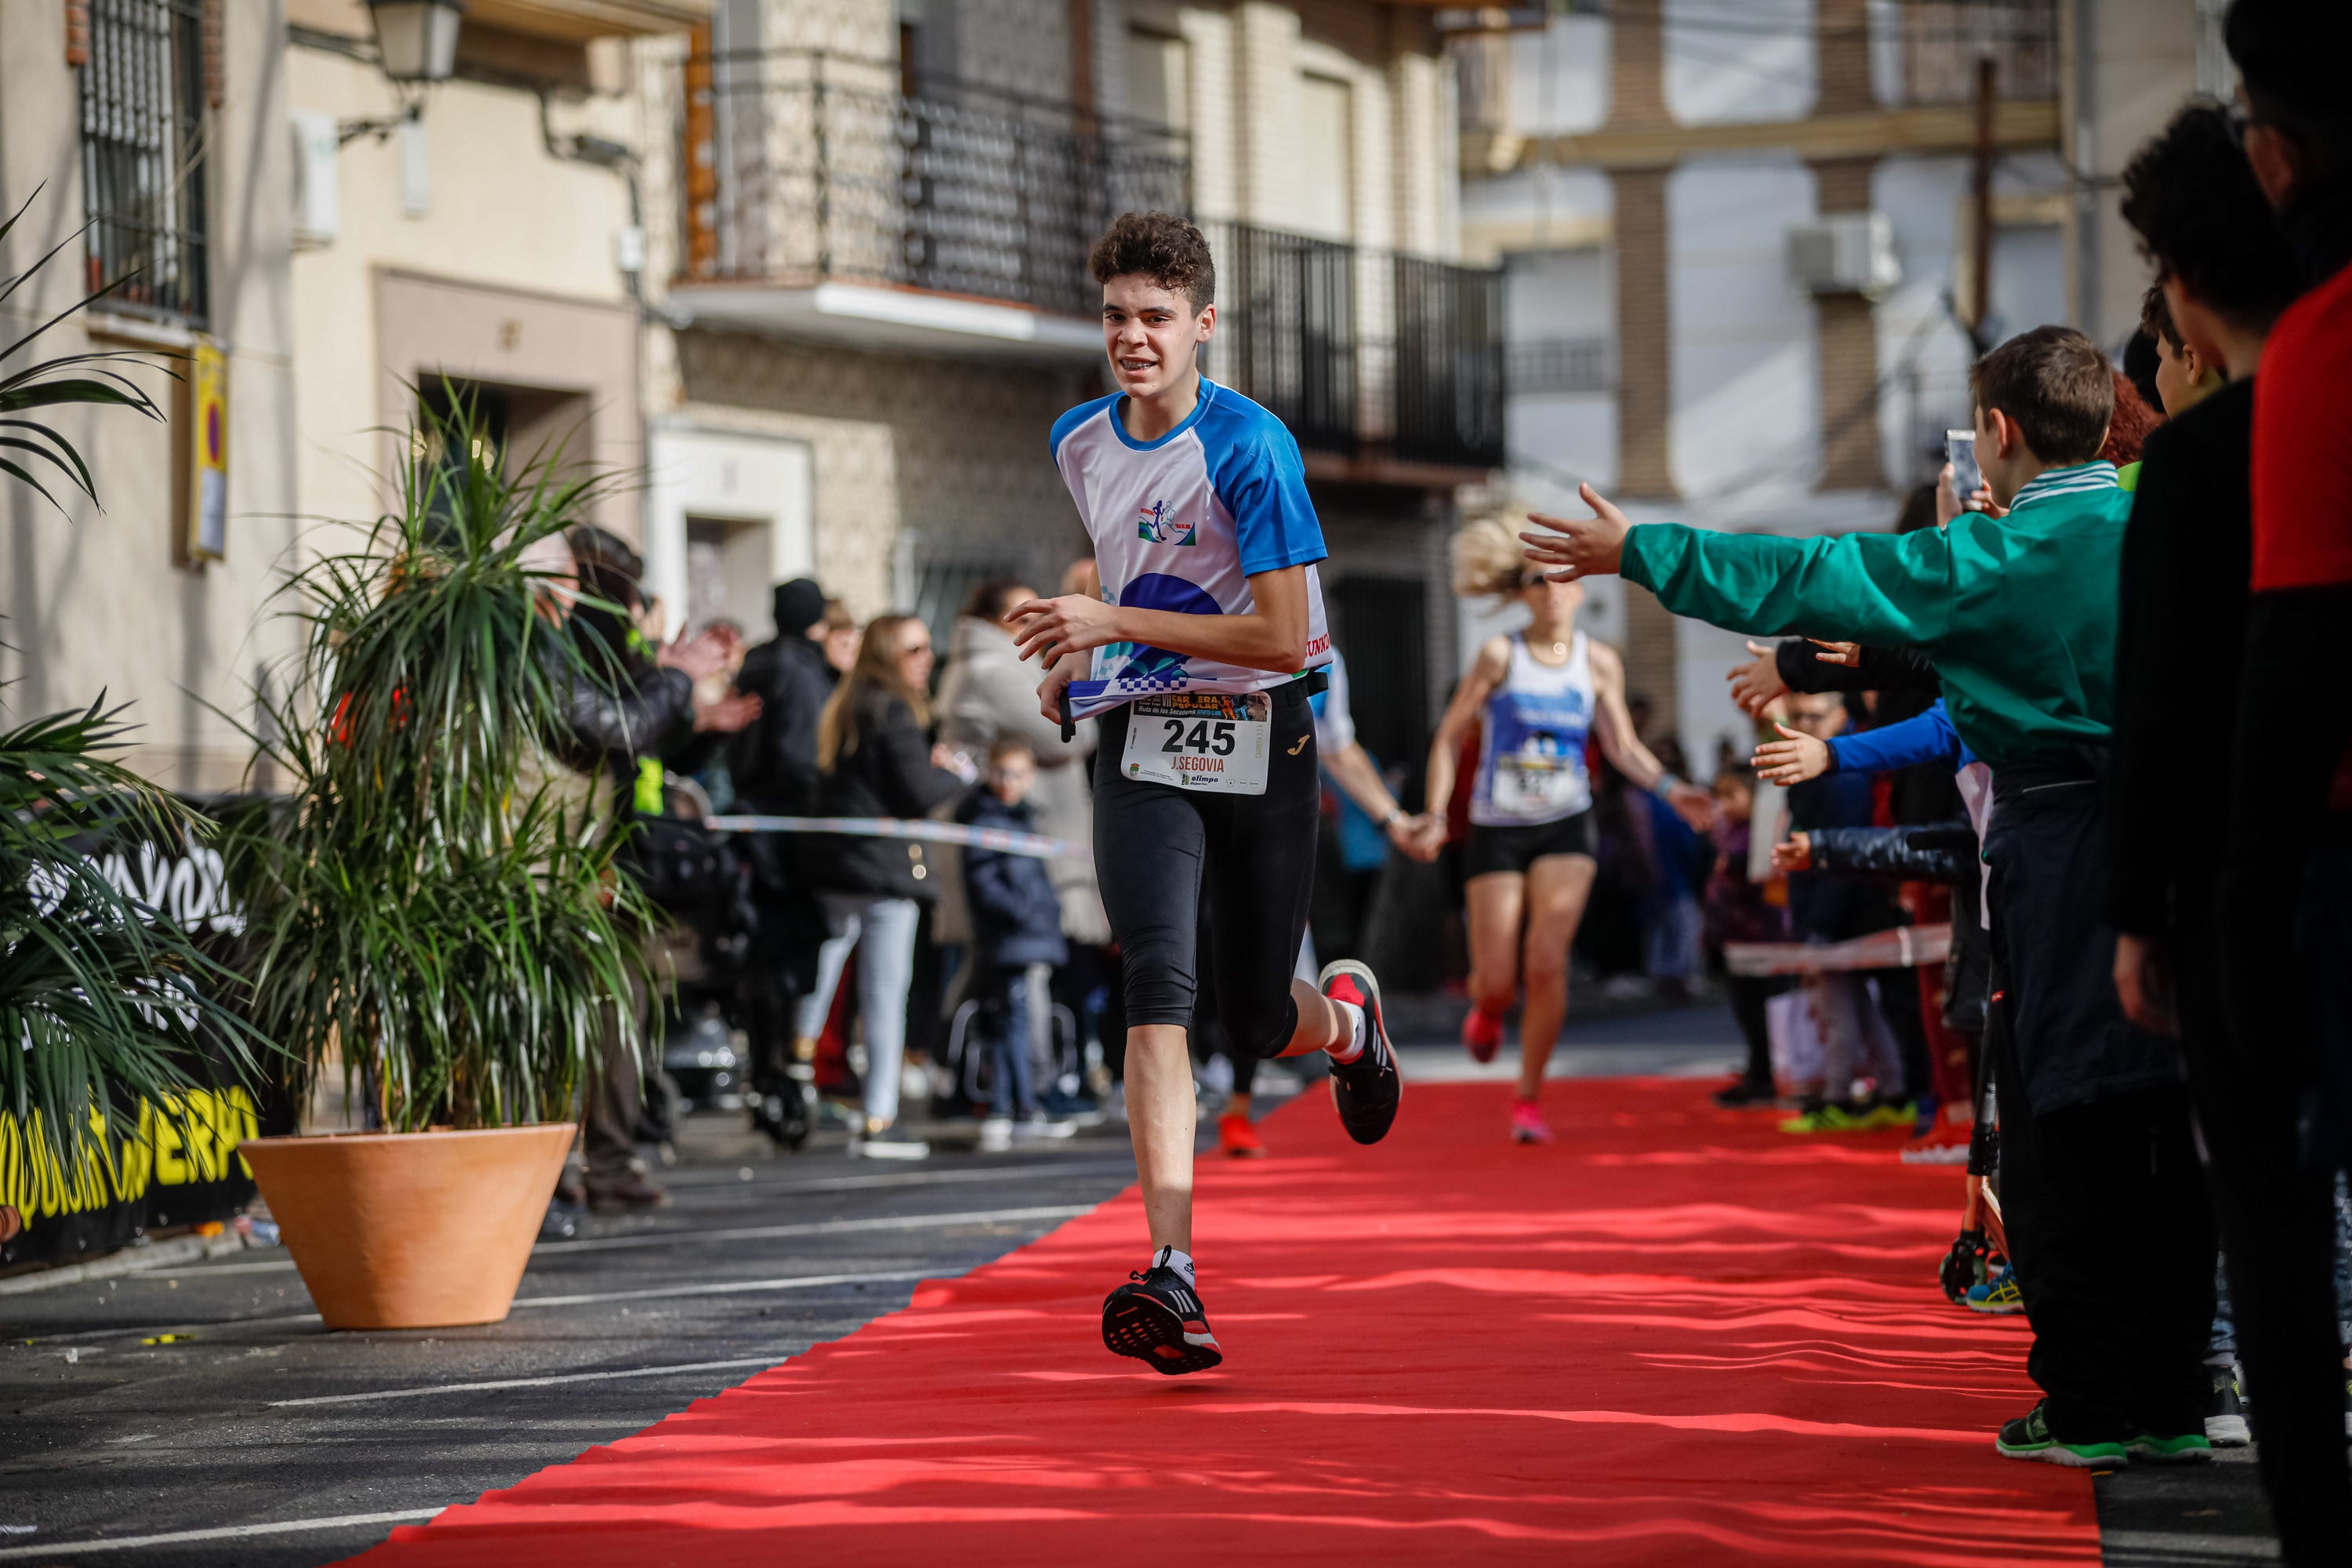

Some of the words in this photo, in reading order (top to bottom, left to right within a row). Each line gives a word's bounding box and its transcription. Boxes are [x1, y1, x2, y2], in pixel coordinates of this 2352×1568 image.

[1171, 695, 1218, 703] CARERA
[1172, 701, 1218, 710] POPULAR
[1161, 720, 1236, 756] 245
[1171, 756, 1225, 773] J.SEGOVIA
[1191, 775, 1218, 783] olimpo
